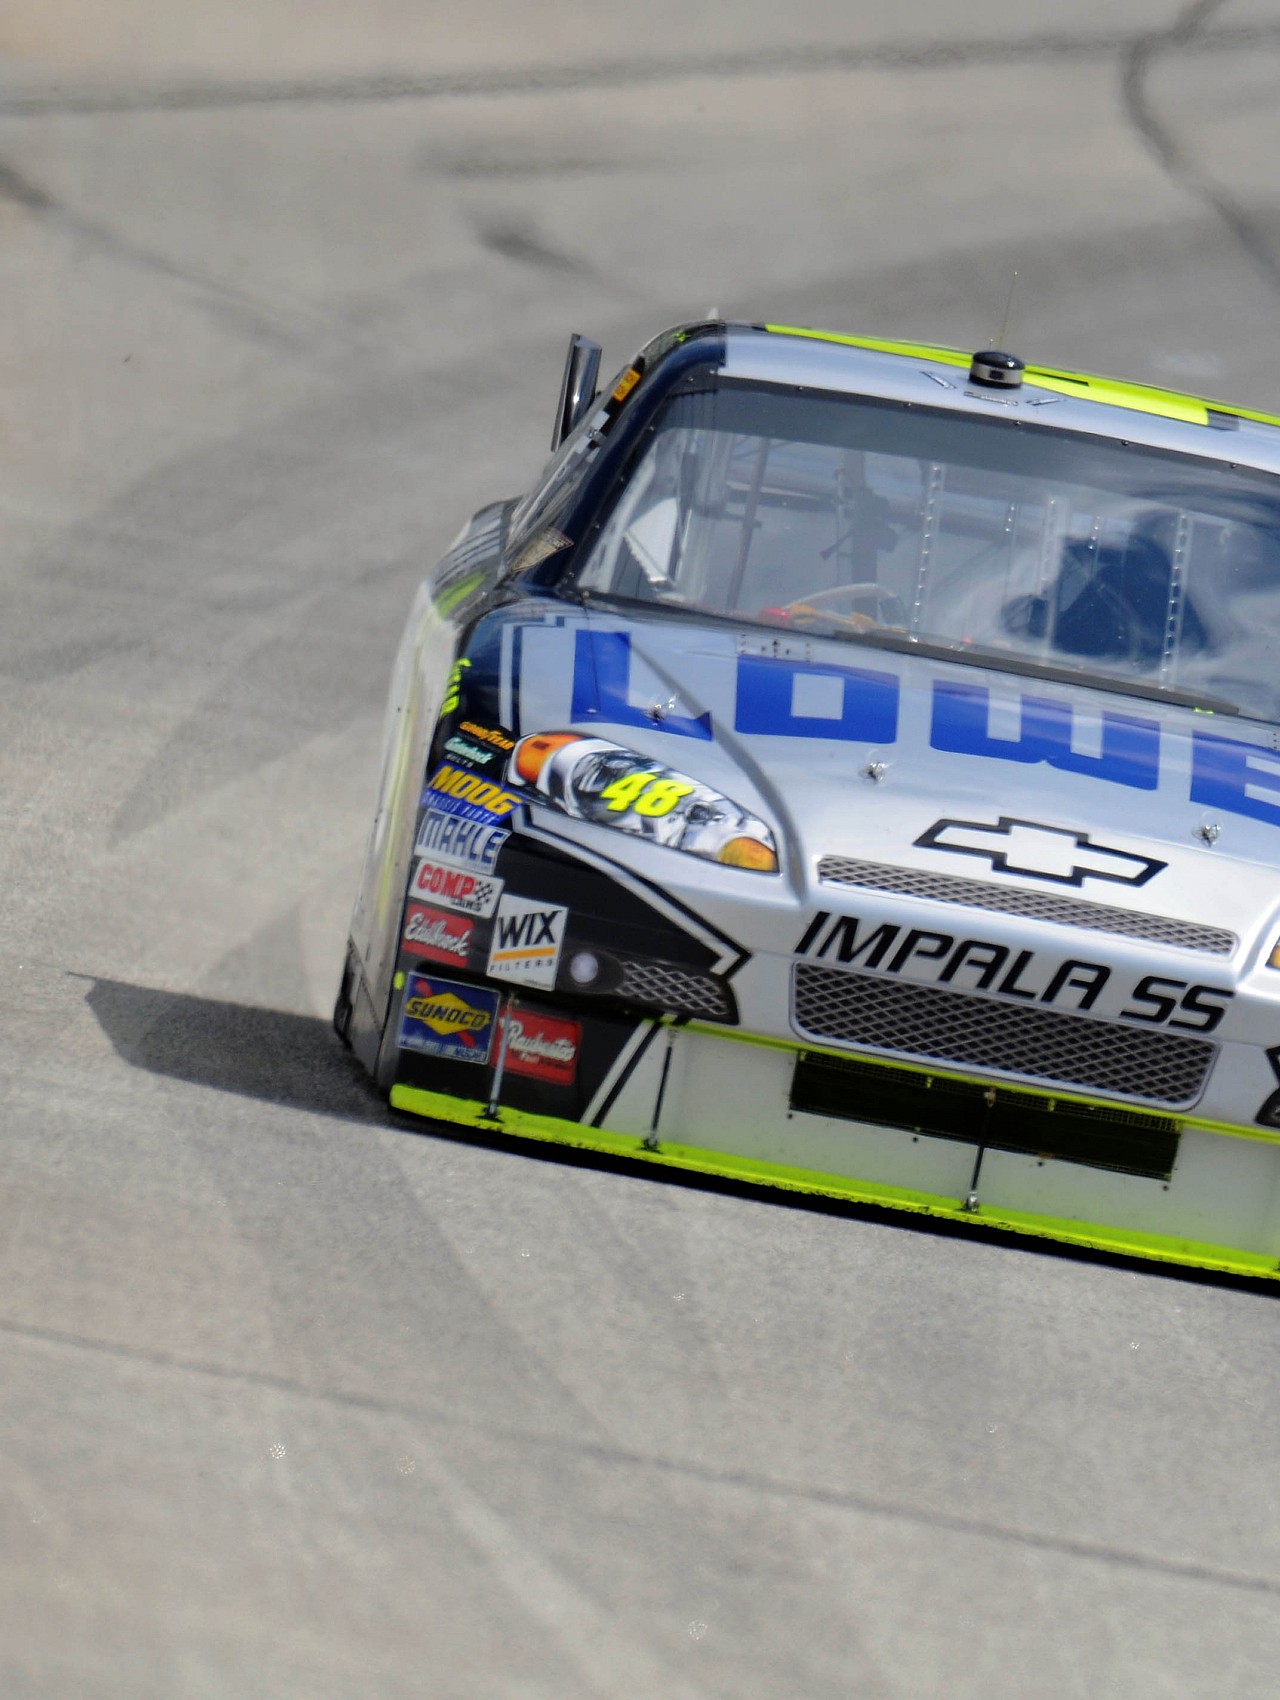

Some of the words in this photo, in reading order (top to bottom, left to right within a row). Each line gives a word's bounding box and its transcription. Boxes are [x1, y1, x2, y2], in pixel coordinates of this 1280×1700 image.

[428, 765, 522, 816] MOOG
[601, 772, 696, 818] 48
[417, 812, 505, 865] MAHLE
[417, 863, 477, 899] COMP
[499, 910, 562, 950] WIX
[489, 959, 555, 974] FILTERS
[794, 911, 1112, 1011] IMPALA
[1119, 974, 1238, 1033] SS
[408, 1001, 487, 1028] SUNOCO
